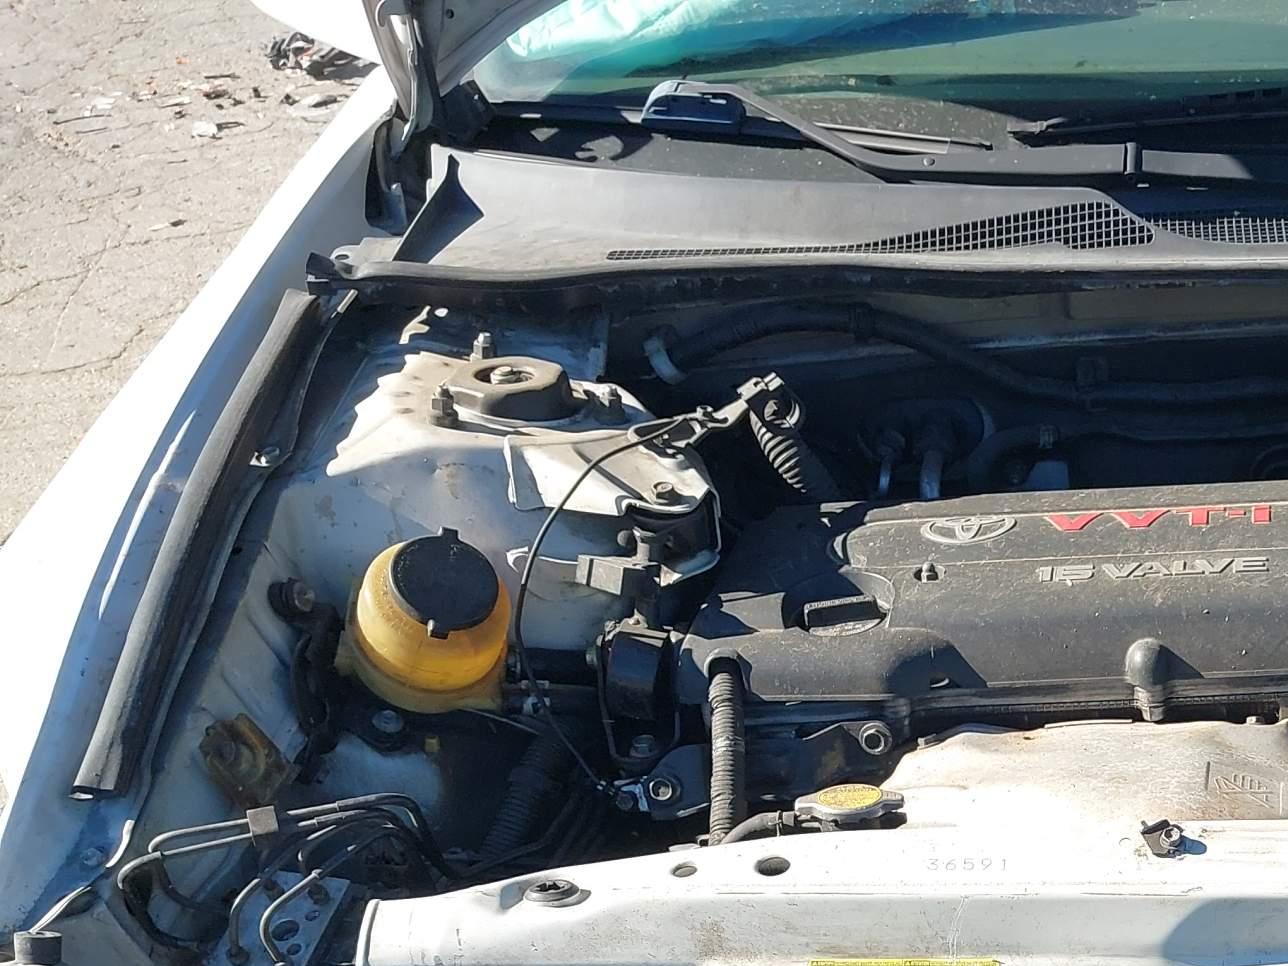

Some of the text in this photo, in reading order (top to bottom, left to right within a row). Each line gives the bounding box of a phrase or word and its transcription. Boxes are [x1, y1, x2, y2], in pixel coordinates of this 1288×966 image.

[1038, 558, 1269, 582] 16 VALVE
[926, 857, 1007, 871] 36591
